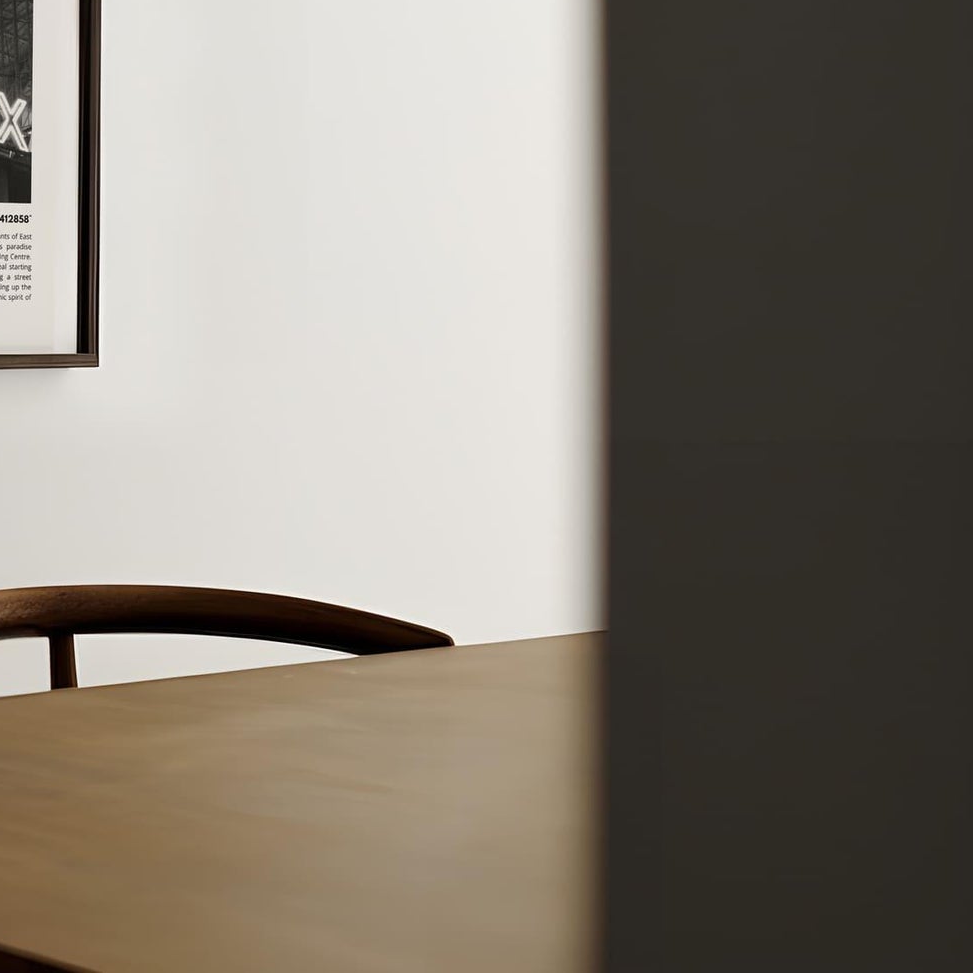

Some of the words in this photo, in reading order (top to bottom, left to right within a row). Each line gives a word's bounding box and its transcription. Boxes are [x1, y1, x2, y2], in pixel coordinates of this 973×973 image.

[11, 232, 18, 240] of
[6, 243, 31, 252] paradise
[9, 263, 32, 272] starting
[14, 273, 31, 281] street
[8, 293, 23, 302] spirit
